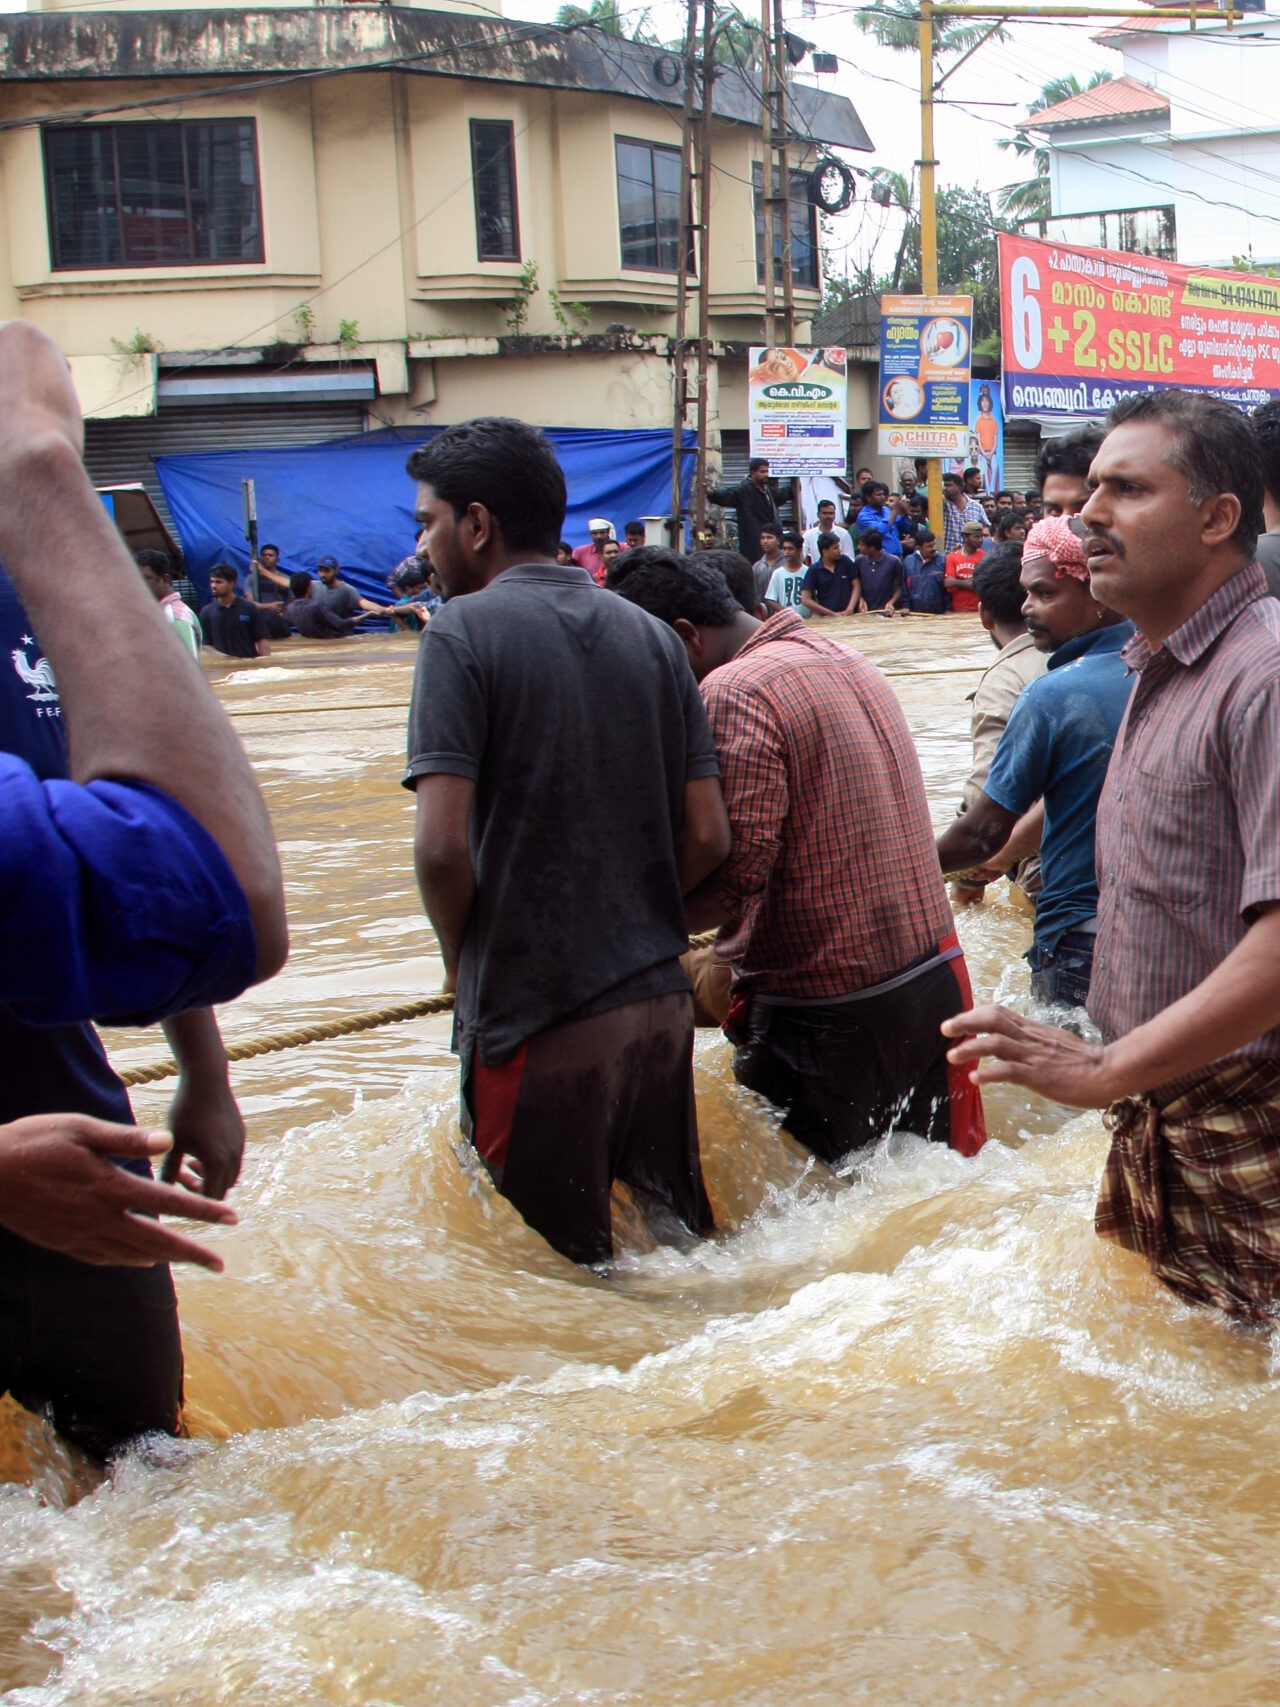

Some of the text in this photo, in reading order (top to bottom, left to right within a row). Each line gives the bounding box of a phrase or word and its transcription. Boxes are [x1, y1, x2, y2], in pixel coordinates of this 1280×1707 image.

[1051, 280, 1105, 309] മാസം
[1010, 256, 1042, 369] 6
[1258, 343, 1270, 359] PSC
[769, 385, 827, 399] കെ.വി.എം
[906, 431, 958, 442] CHITRA
